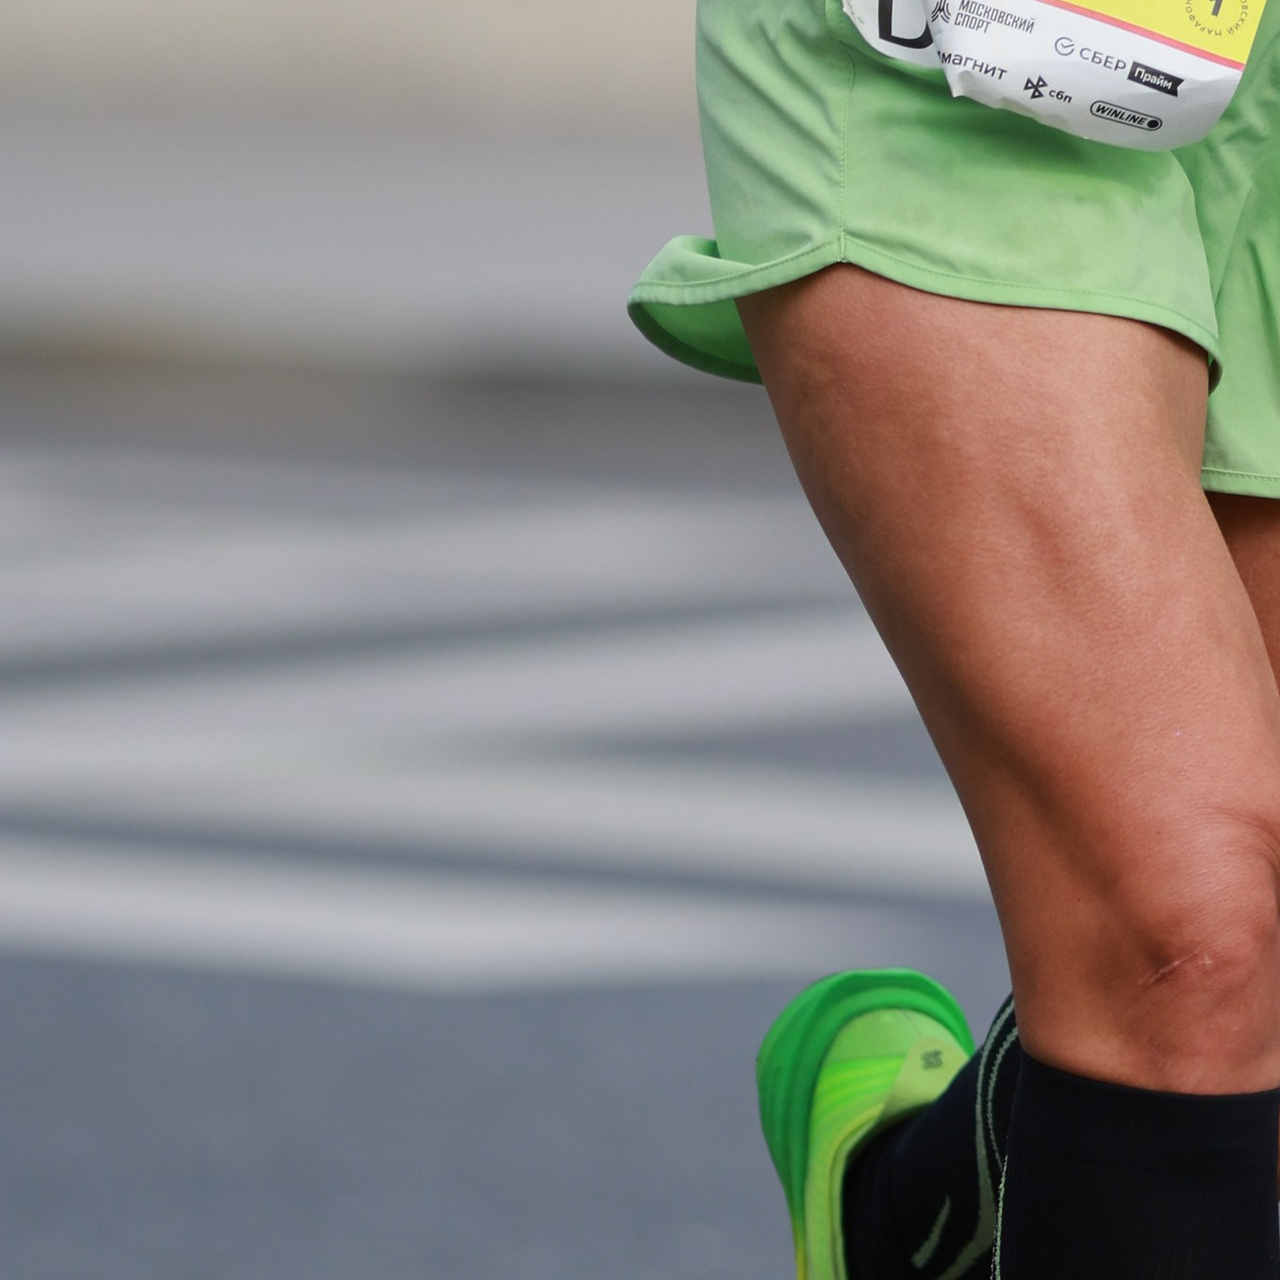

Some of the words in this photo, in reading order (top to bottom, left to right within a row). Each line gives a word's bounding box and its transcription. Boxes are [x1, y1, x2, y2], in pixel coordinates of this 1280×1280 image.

[954, 12, 991, 34] СПОРТ
[1079, 47, 1127, 72] СБЕР
[1134, 66, 1173, 90] Прайм
[1048, 89, 1072, 104] сбп
[1095, 104, 1147, 126] WINLINE
